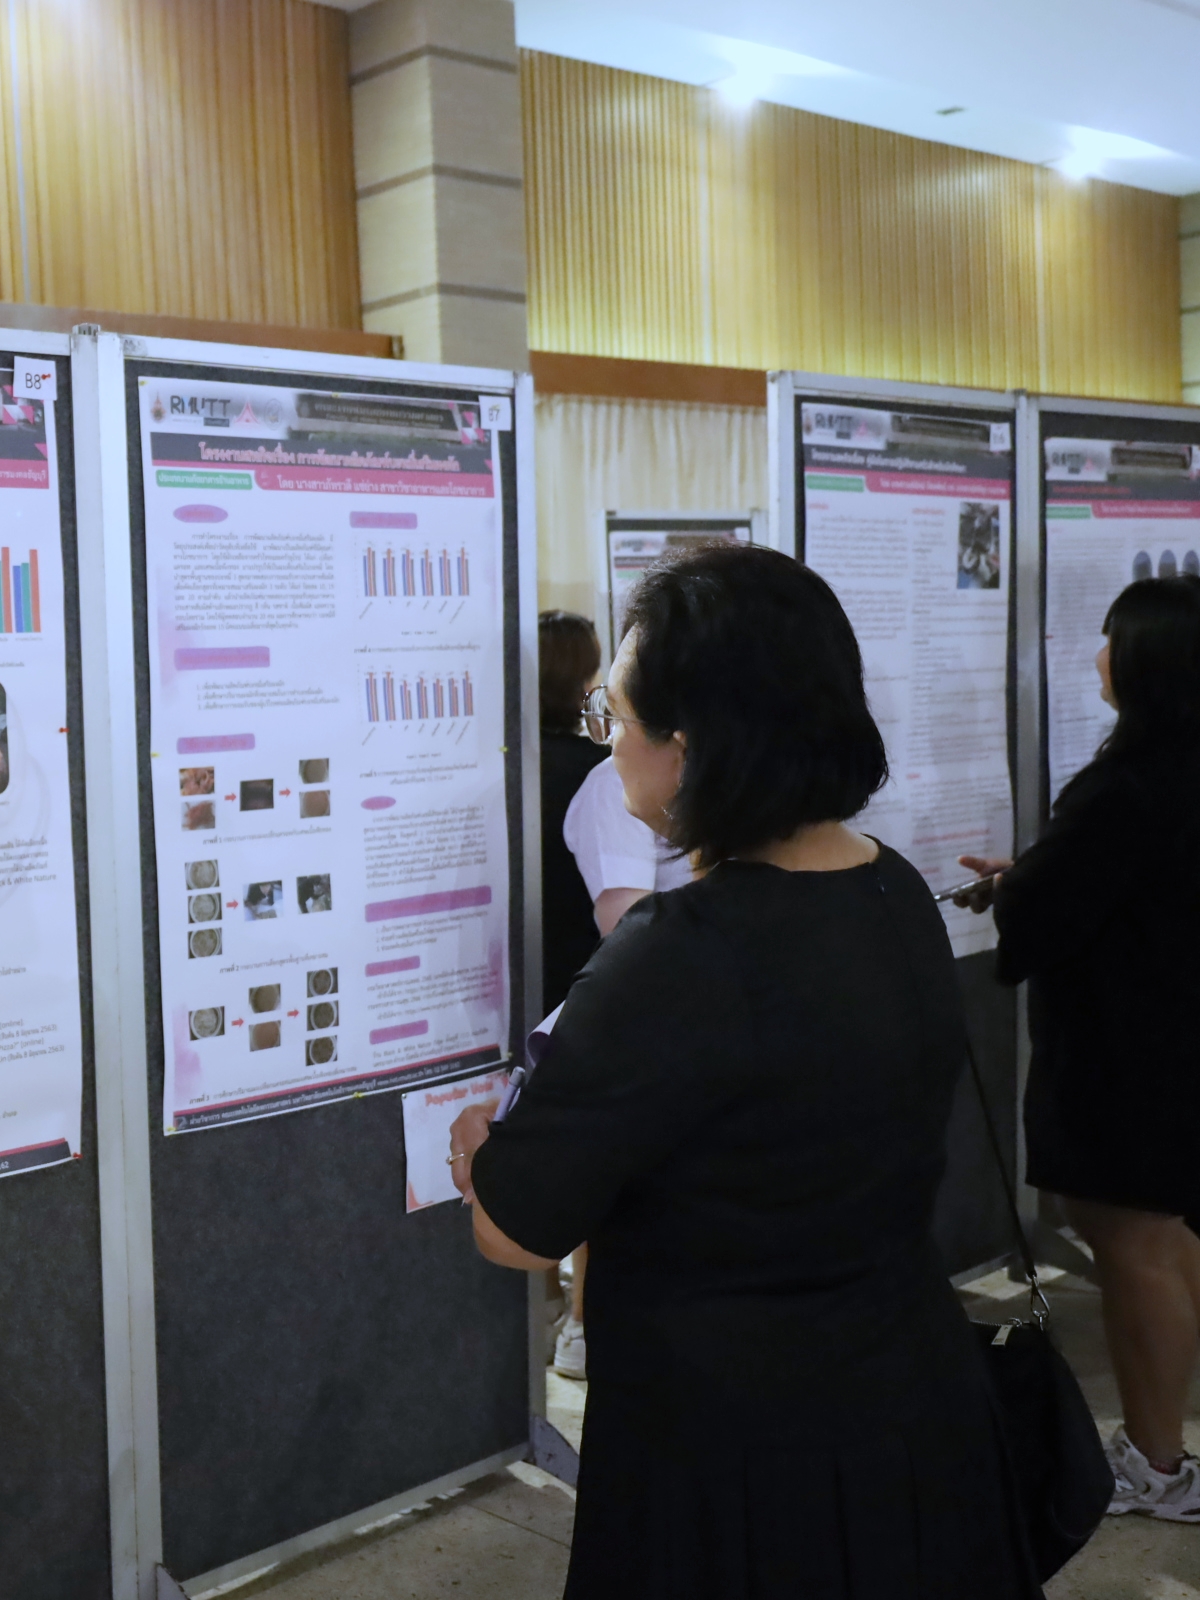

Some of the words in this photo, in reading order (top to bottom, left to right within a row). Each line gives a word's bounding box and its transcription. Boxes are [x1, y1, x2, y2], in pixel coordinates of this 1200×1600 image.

[25, 373, 42, 389] B8
[170, 395, 231, 417] RMUTT
[13, 876, 32, 885] White
[34, 873, 57, 883] Nature
